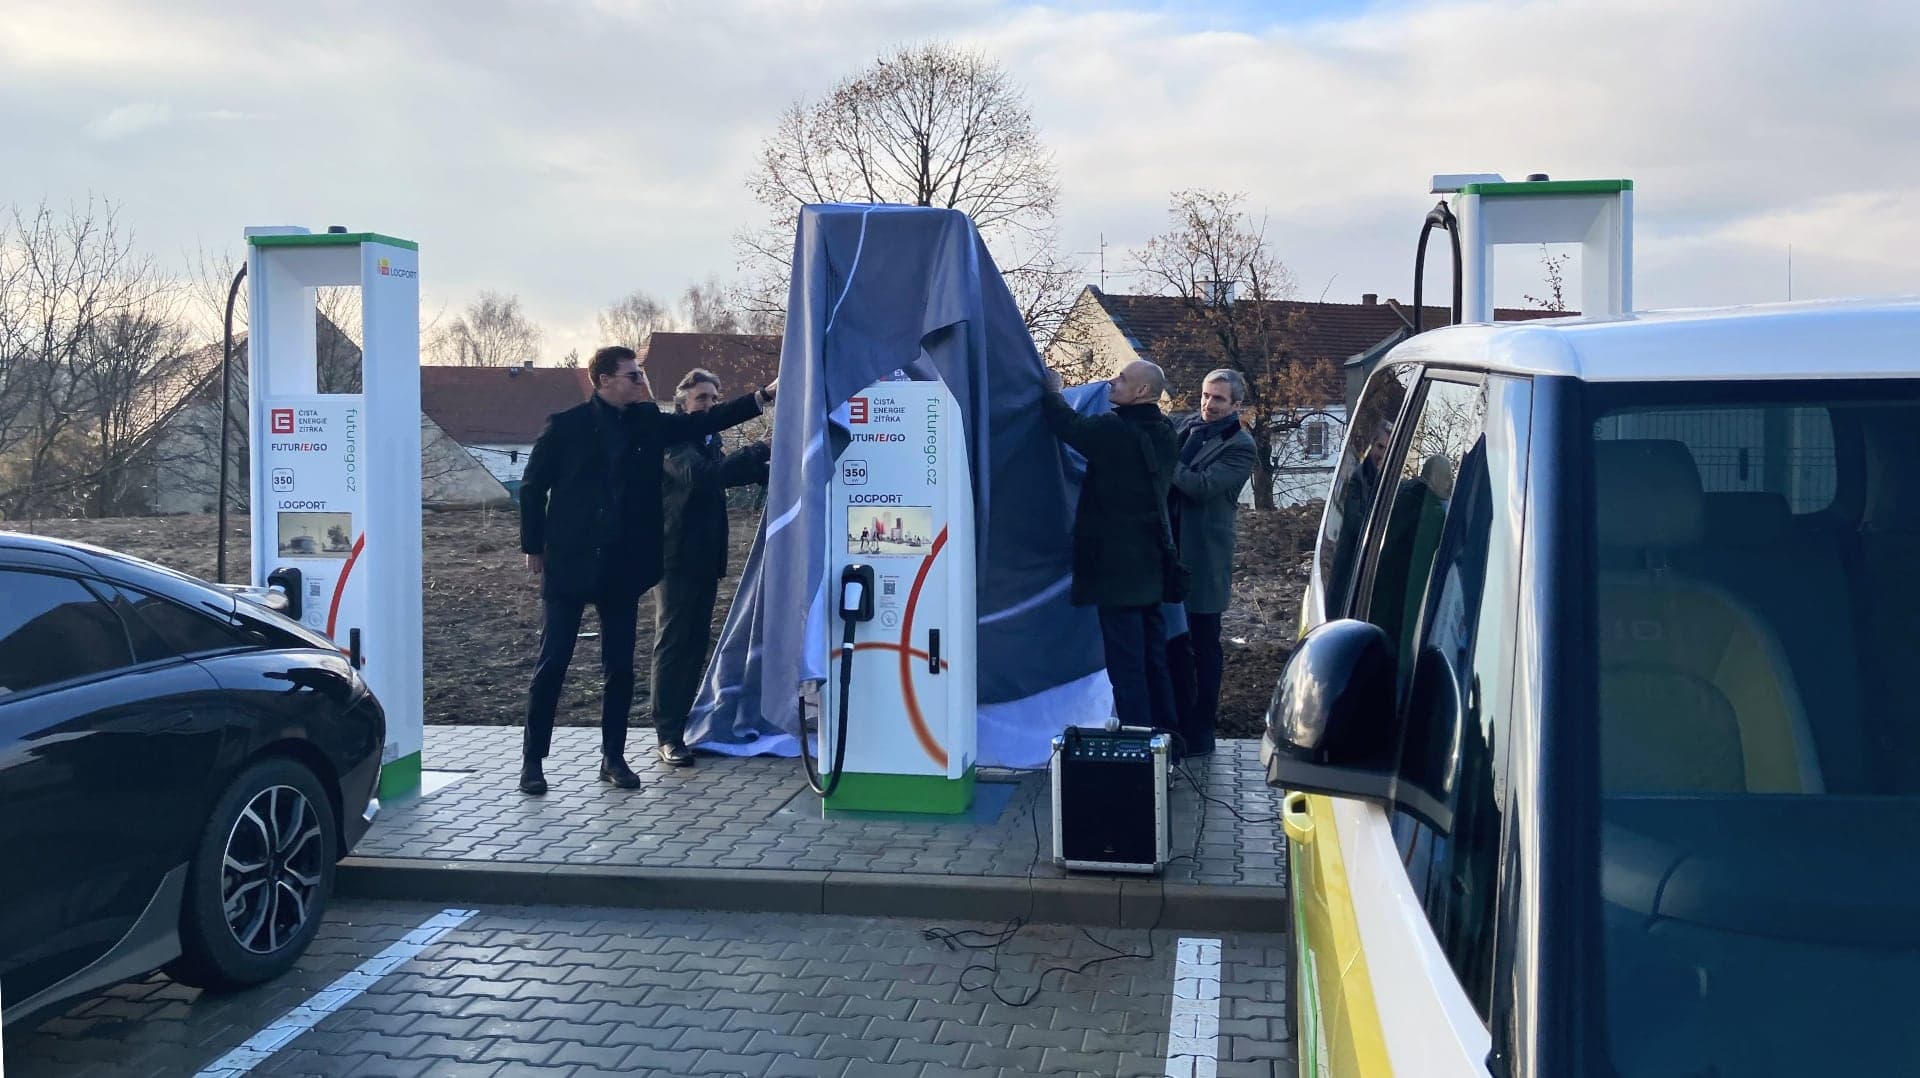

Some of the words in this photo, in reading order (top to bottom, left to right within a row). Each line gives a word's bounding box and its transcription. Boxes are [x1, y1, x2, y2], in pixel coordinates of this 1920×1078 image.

[390, 266, 417, 279] LOGPORT
[298, 417, 327, 425] ENERGIE
[850, 433, 905, 442] UTUR/E/GO
[924, 397, 940, 486] futurego.cz
[271, 443, 328, 451] FUTUR/E/GO
[344, 408, 358, 492] futurego.cz
[845, 468, 866, 477] 350
[274, 476, 292, 485] 350
[849, 494, 903, 503] LOGPORT
[278, 500, 327, 509] LOGPORT
